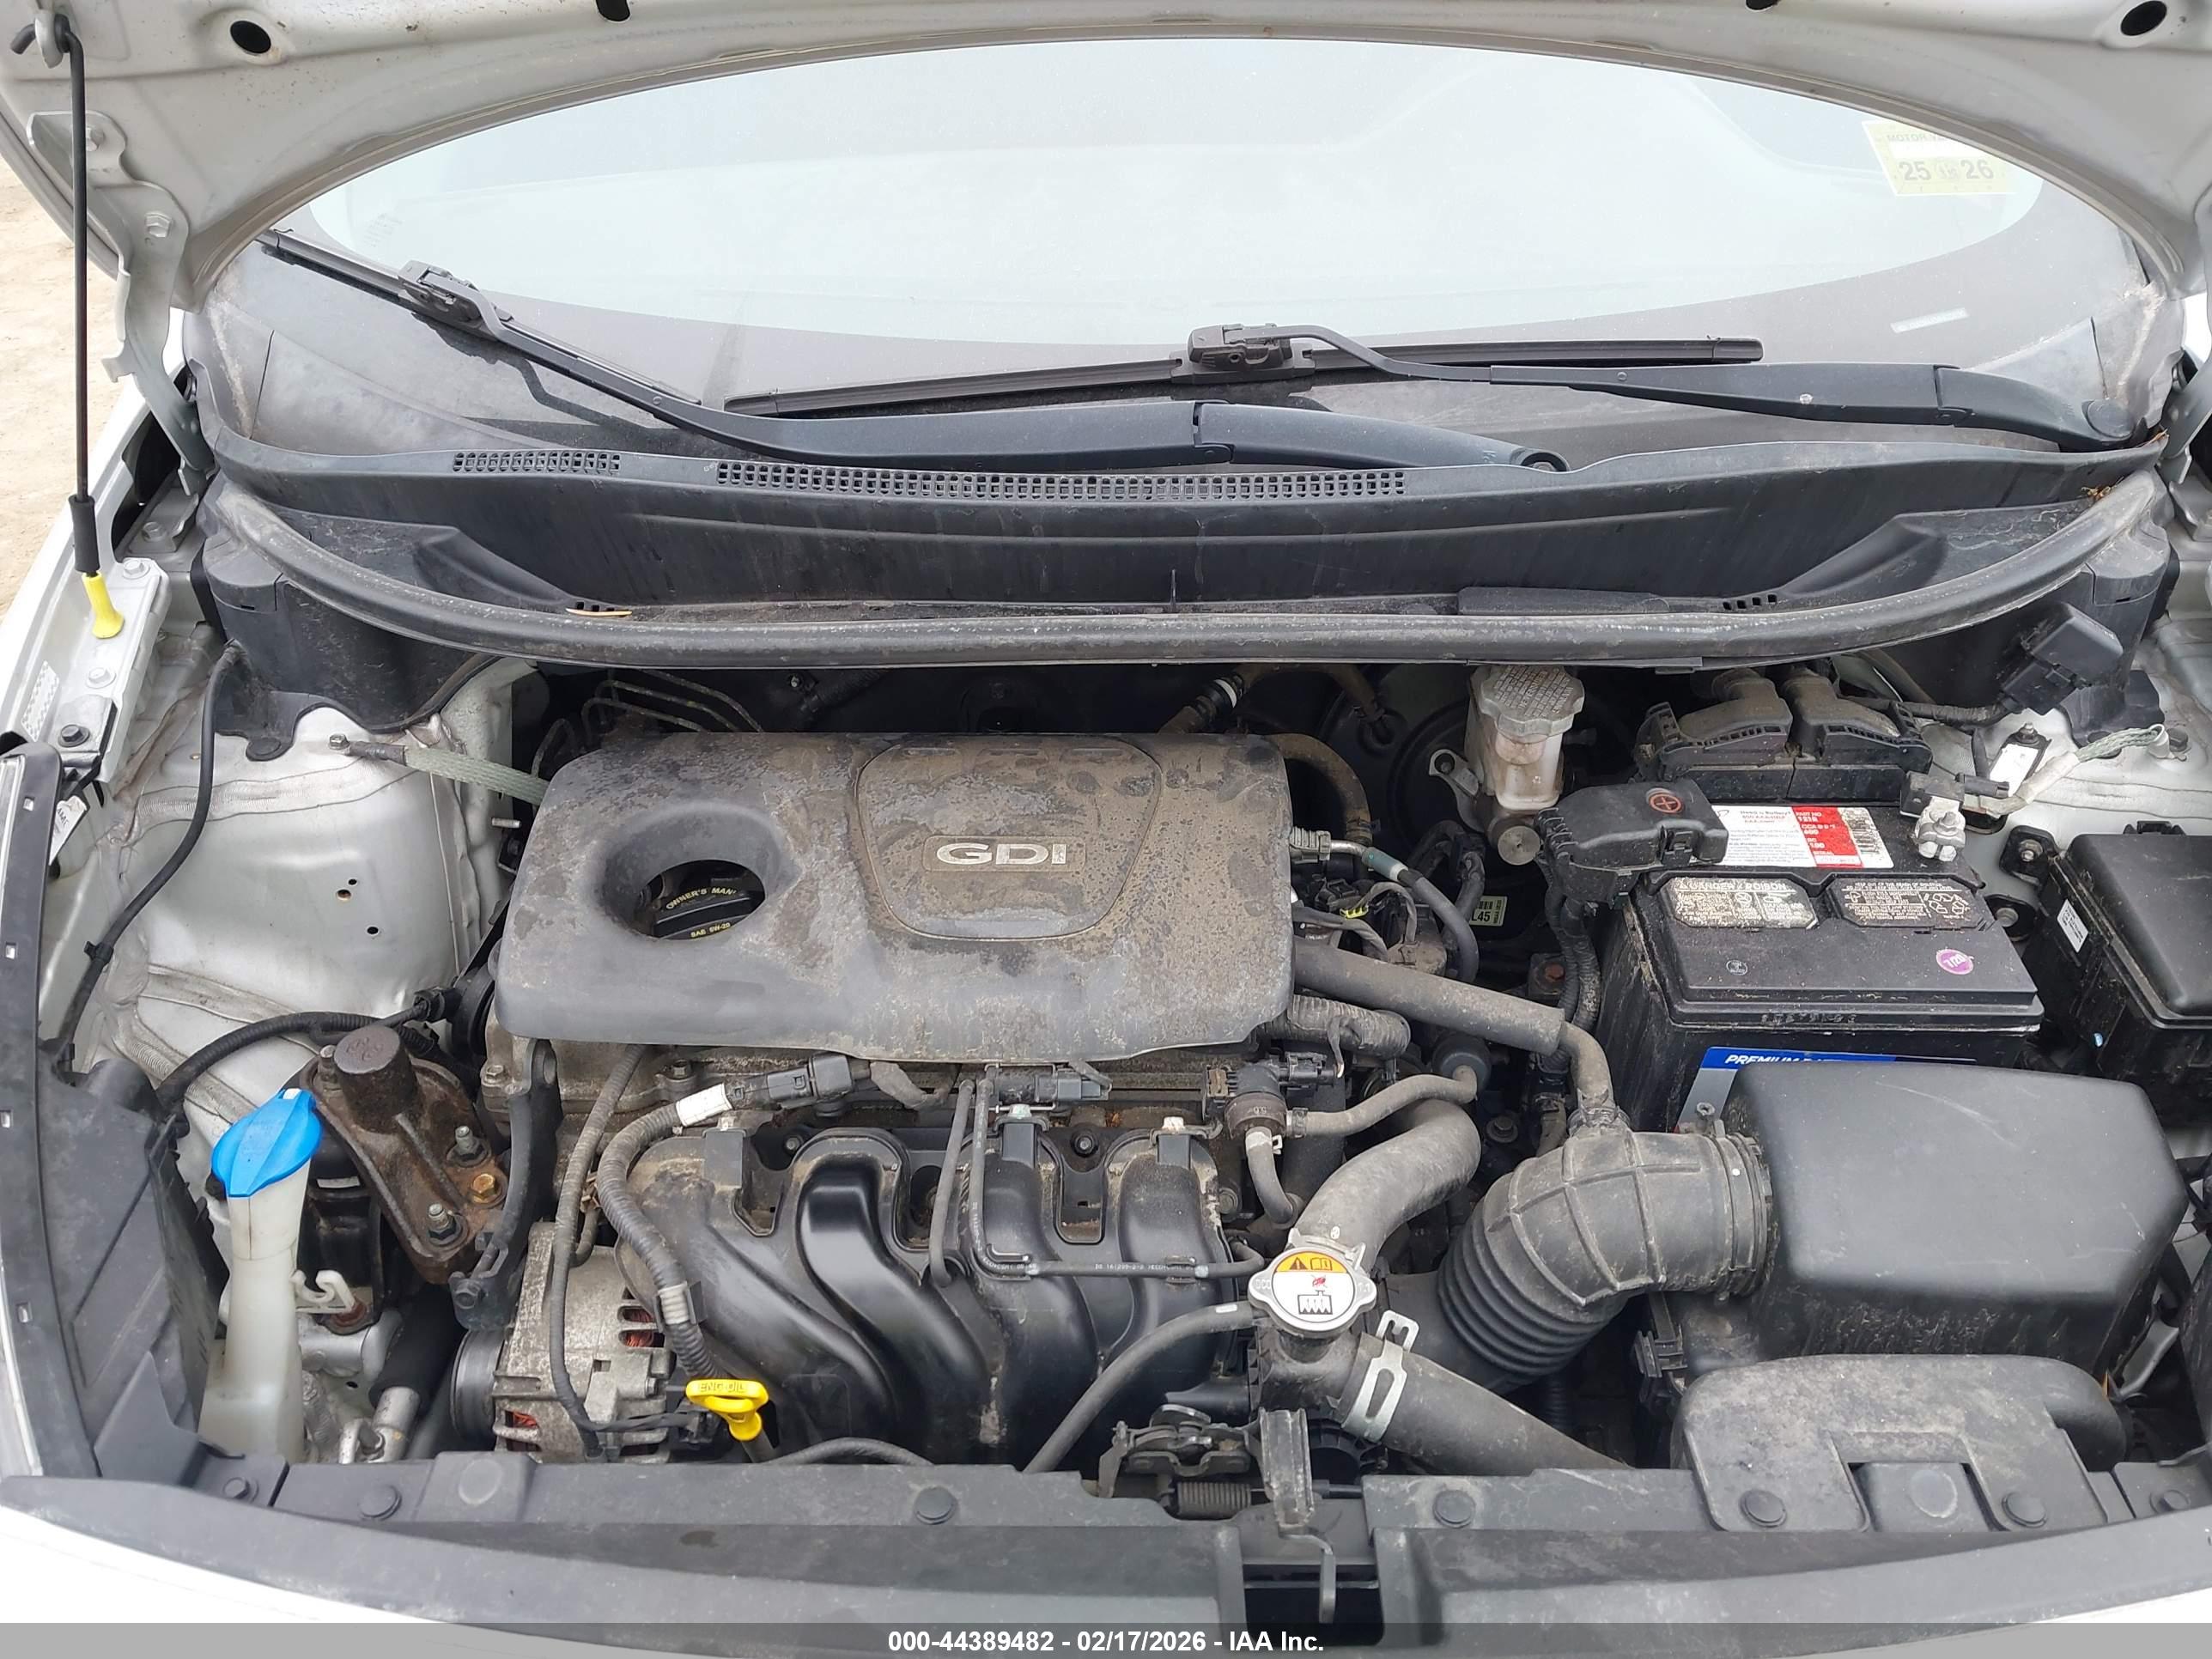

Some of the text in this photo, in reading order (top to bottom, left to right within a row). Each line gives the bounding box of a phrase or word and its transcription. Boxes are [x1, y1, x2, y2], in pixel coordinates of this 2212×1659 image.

[1898, 161, 1932, 181] 25
[1960, 159, 1994, 179] 26
[936, 842, 1066, 866] GDI
[1745, 883, 1787, 891] POISON
[665, 888, 708, 909] OWNER'S
[1942, 953, 1966, 969] 7/20
